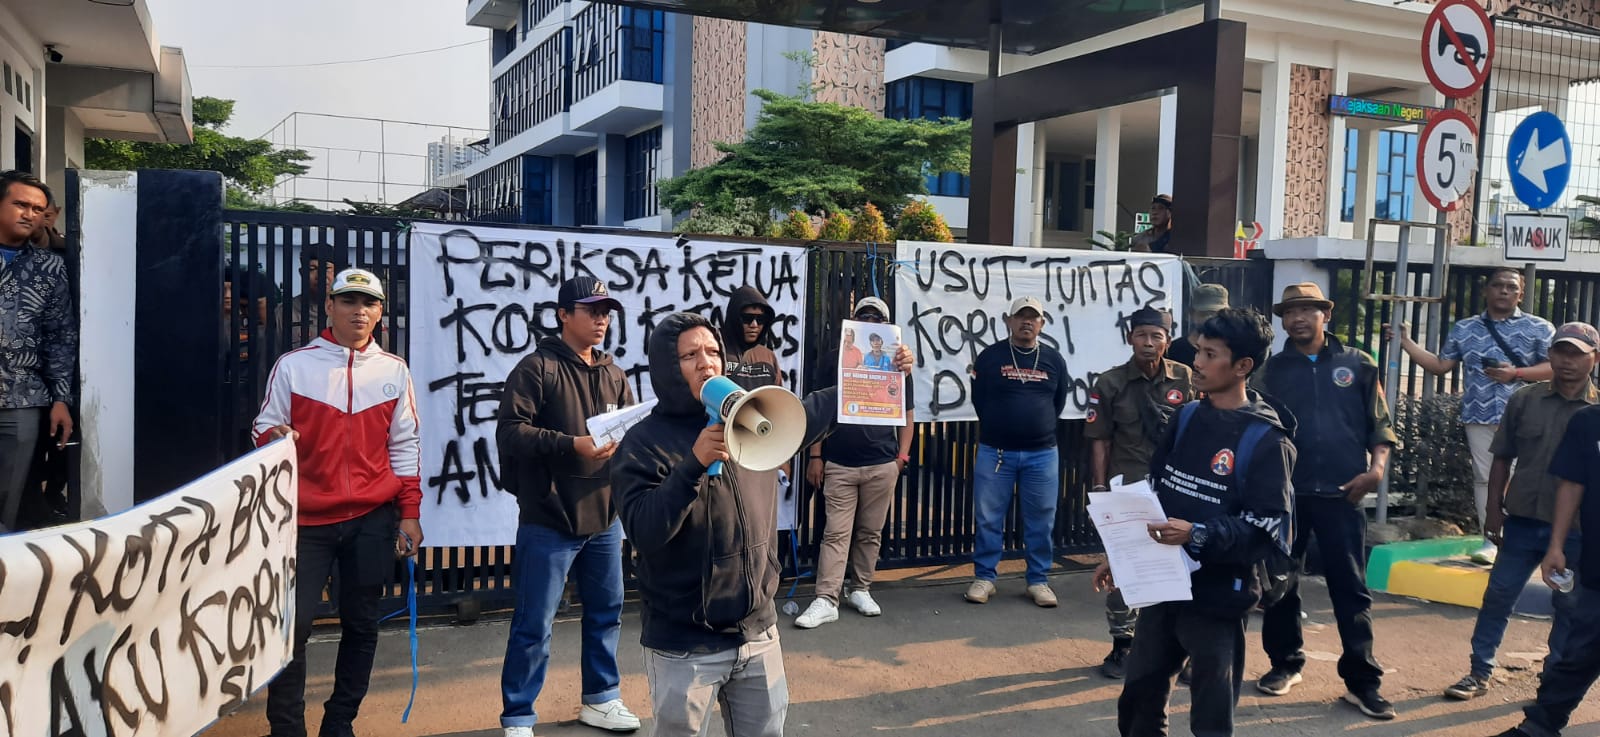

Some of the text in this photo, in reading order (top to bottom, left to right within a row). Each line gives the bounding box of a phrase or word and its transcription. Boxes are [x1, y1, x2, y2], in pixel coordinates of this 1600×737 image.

[1340, 97, 1390, 115] Kejaksaan
[1436, 132, 1473, 189] 5 km
[436, 228, 799, 301] PERIKSA KETUA
[1511, 225, 1562, 249] MASUK
[915, 247, 1027, 300] USUT
[60, 496, 220, 645] KOTA
[225, 459, 293, 564] BKS
